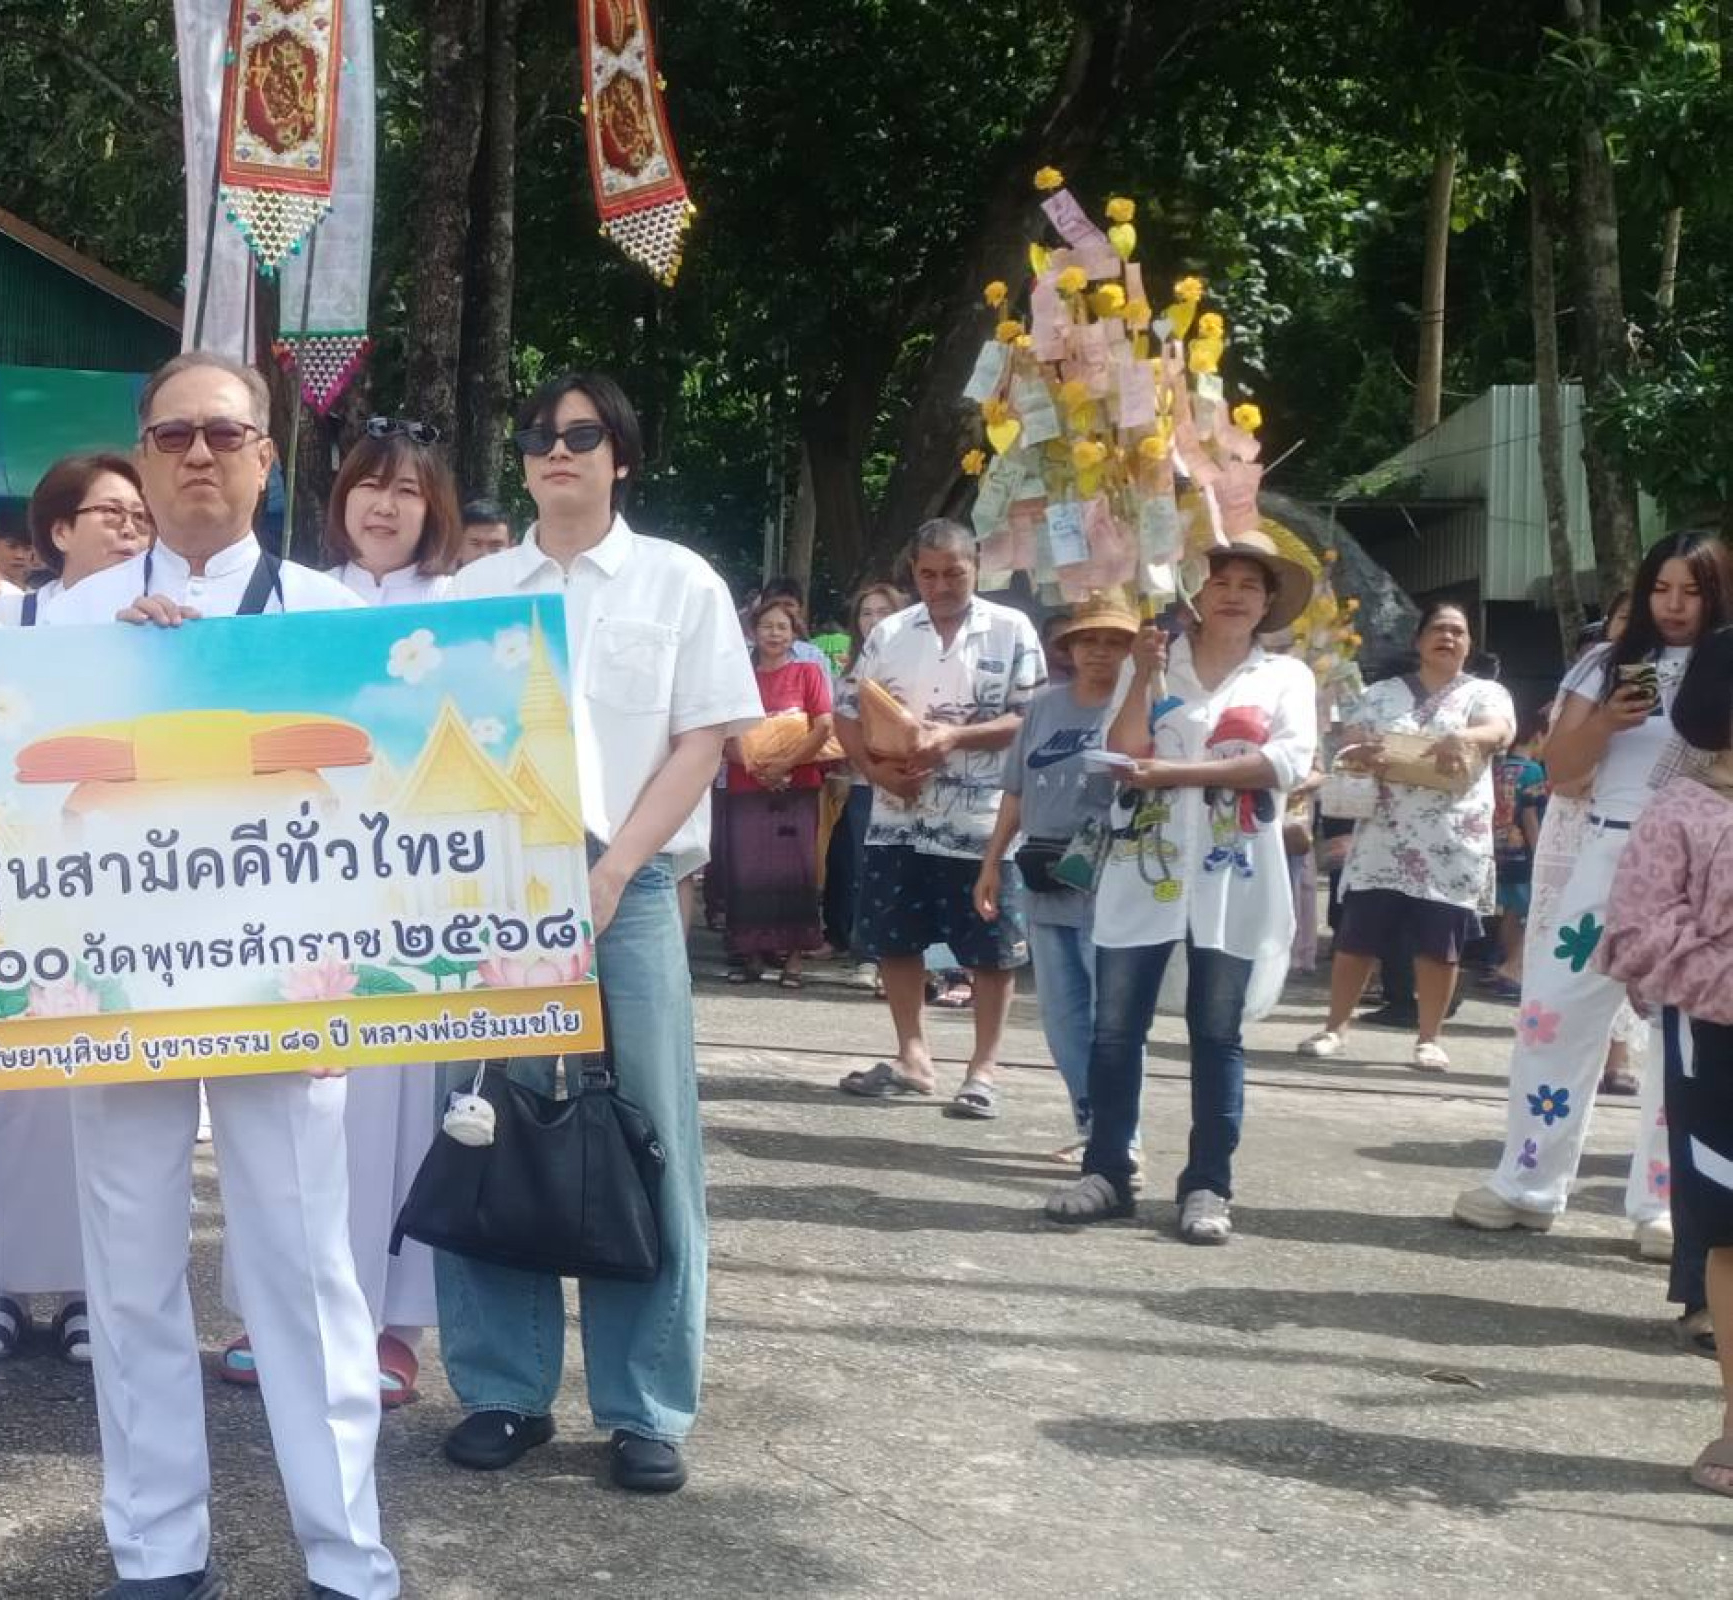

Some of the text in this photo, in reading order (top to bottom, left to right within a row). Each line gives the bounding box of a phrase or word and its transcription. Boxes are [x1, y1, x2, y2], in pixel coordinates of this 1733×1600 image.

[1037, 773, 1088, 788] AIR
[83, 923, 381, 987] วัดพุทธศักราช
[392, 908, 578, 958] ๒๕๖๘
[142, 1032, 270, 1069] บูชาธรรม
[281, 1030, 320, 1050] ๘๑
[330, 1018, 349, 1047] ปี
[359, 1005, 580, 1046] หลวงพ่อธัมมชโย
